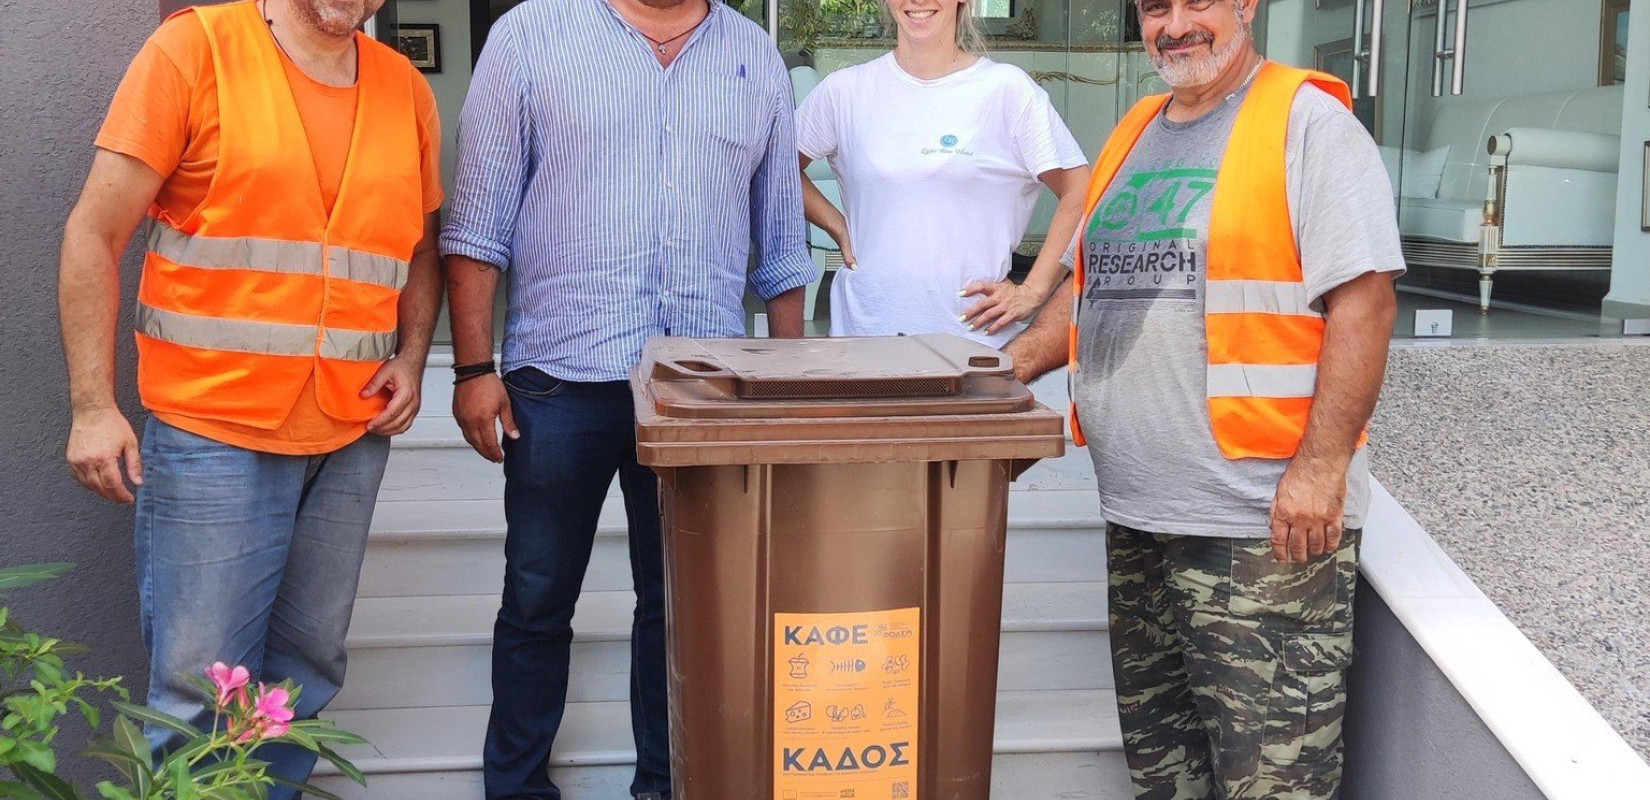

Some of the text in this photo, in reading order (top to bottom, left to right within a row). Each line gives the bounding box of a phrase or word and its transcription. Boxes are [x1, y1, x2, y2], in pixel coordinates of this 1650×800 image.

[1088, 239, 1195, 252] ORIGINAL
[1088, 251, 1196, 274] RESEARCH
[1087, 274, 1196, 286] GROUP
[784, 624, 869, 646] ΚΑΦΕ
[783, 741, 909, 771] ΚΑΔΟΣ
